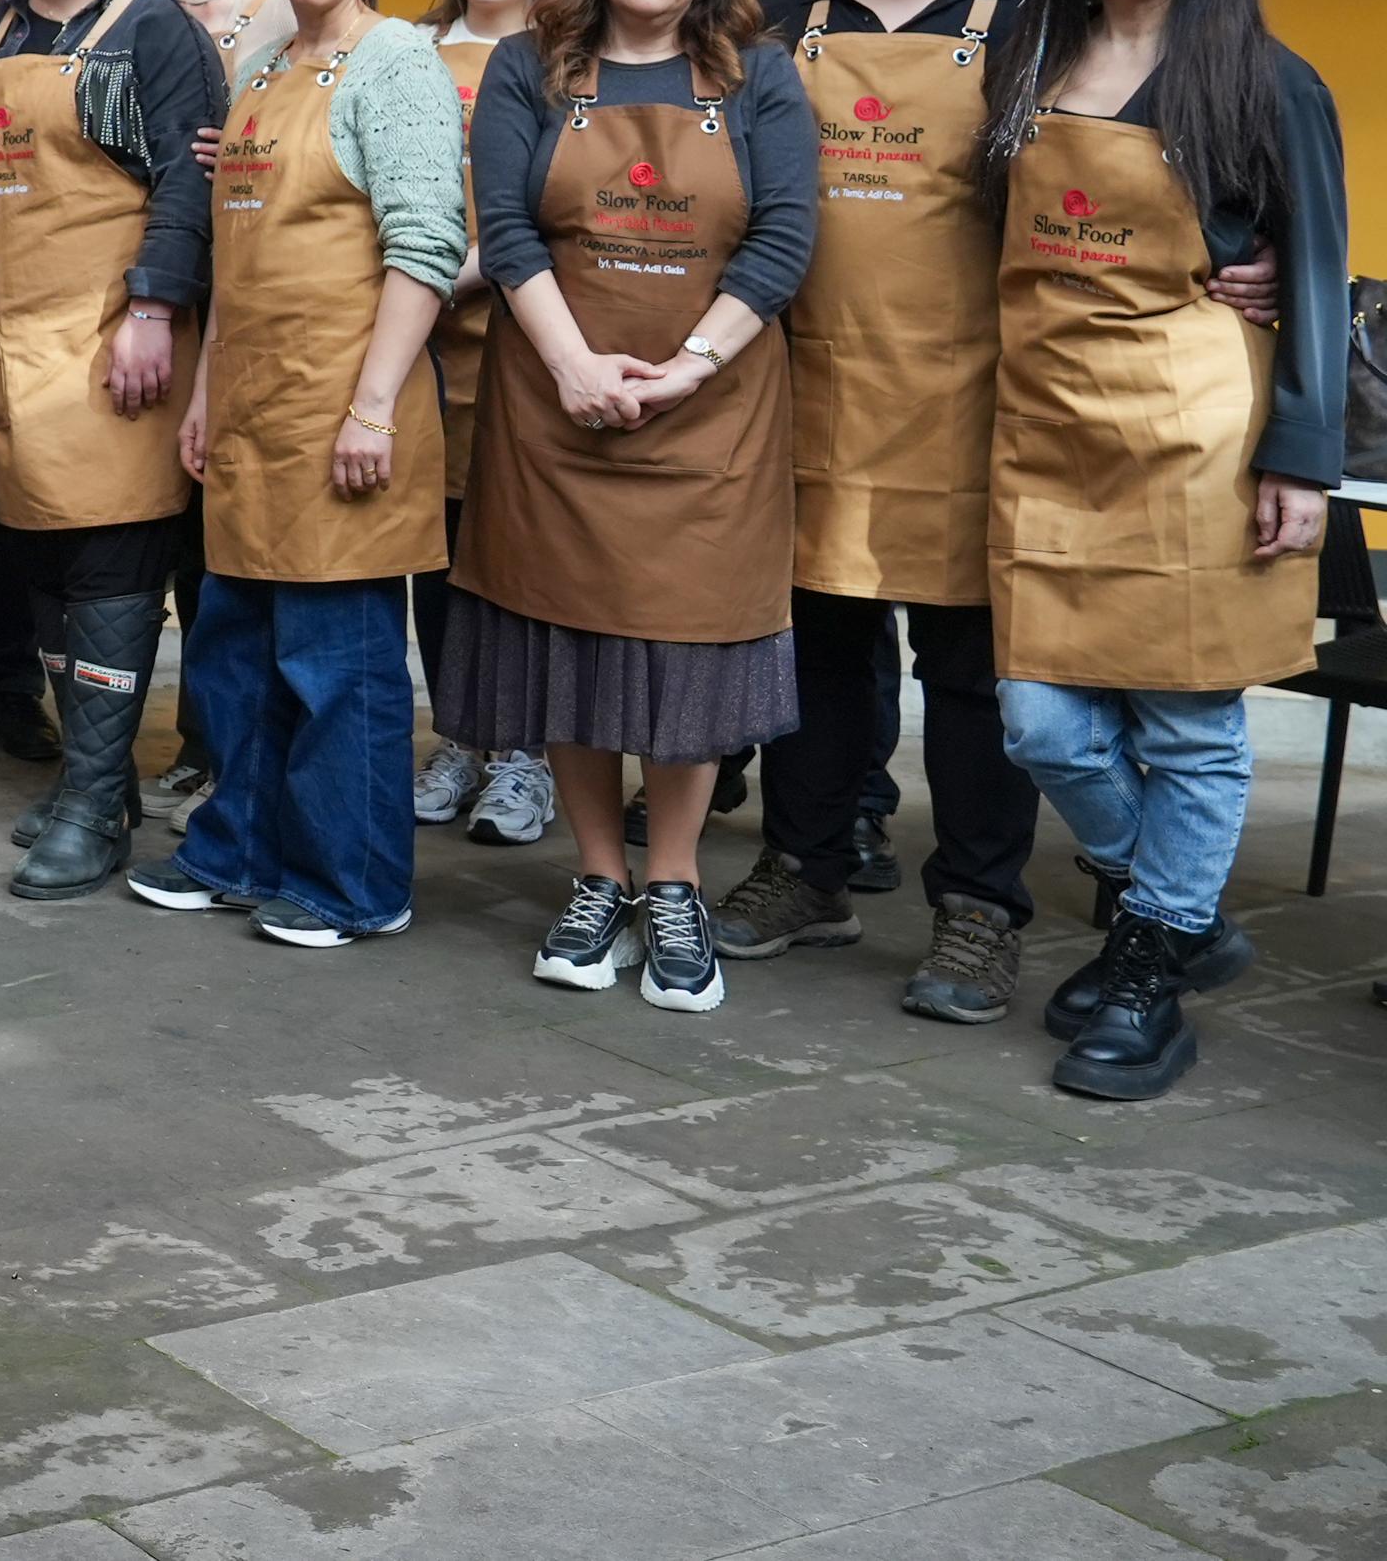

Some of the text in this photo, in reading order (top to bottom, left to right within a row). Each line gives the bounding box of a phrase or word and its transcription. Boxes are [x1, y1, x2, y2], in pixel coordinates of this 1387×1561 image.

[820, 122, 865, 141] Slow
[223, 142, 242, 157] Slw
[843, 172, 888, 185] TARSUS
[596, 190, 639, 208] Slow
[1034, 214, 1071, 237] Slow
[579, 238, 648, 257] KAPADOKYA
